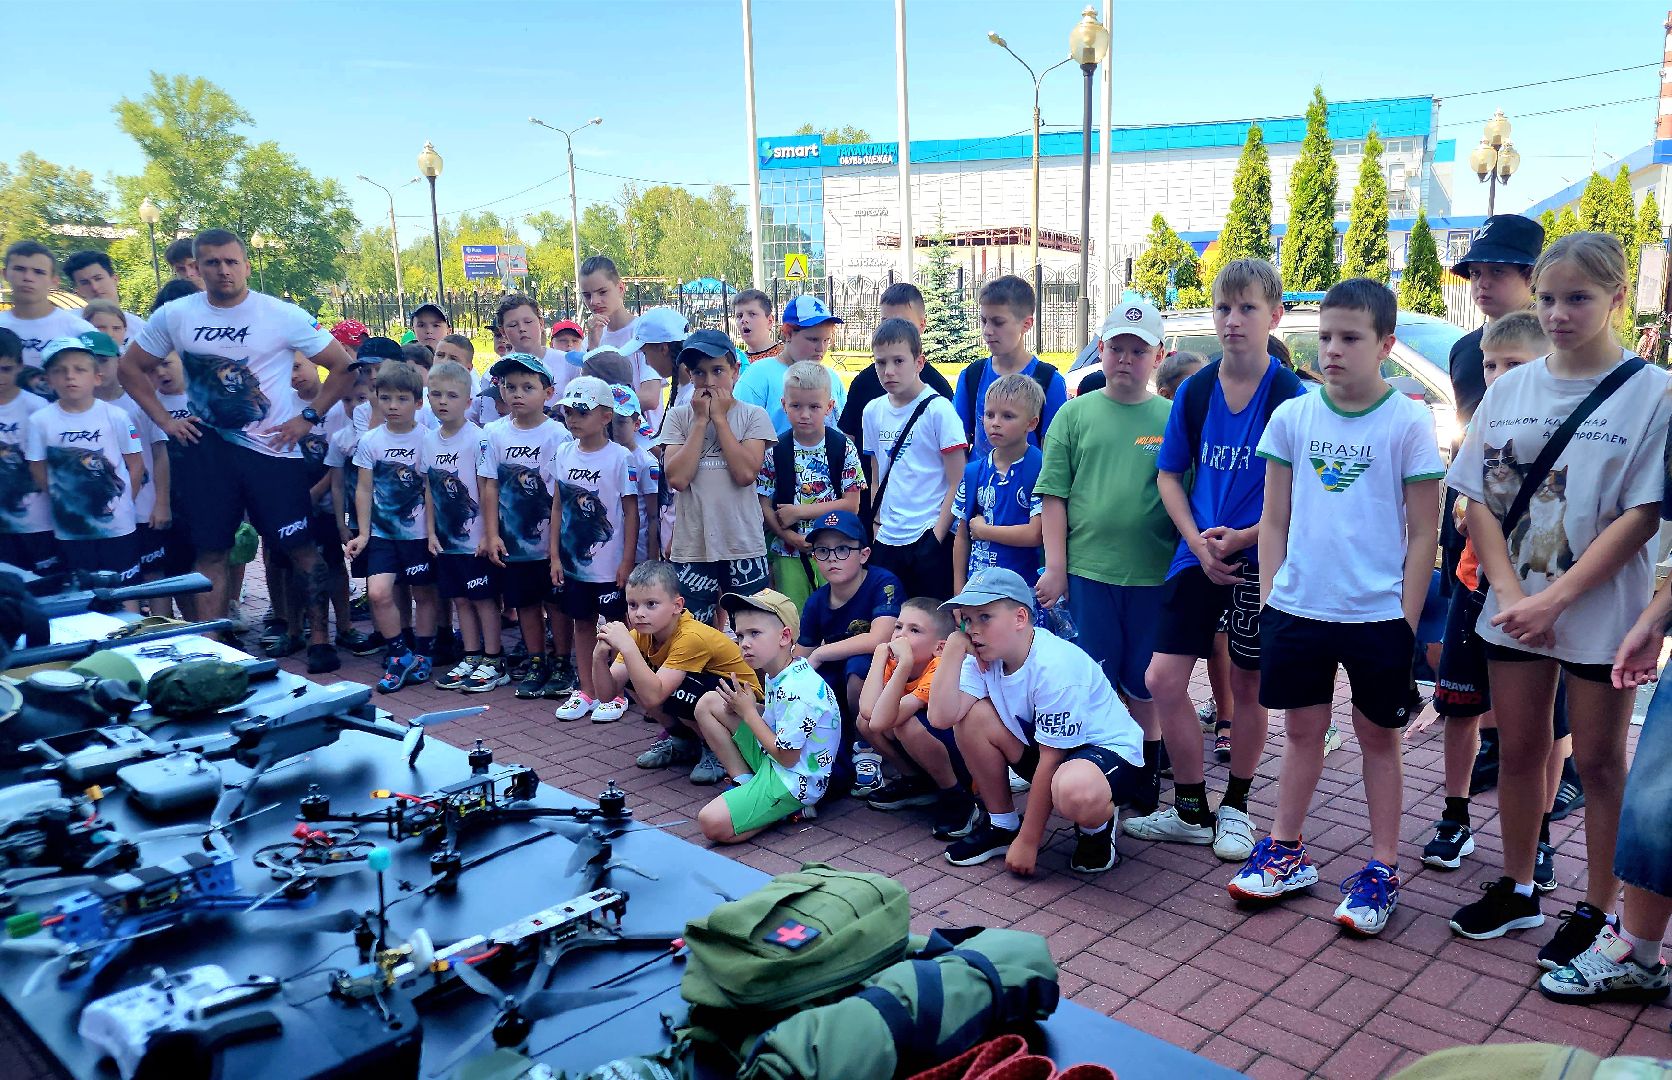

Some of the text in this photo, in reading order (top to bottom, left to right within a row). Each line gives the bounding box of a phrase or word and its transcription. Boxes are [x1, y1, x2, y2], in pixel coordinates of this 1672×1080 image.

[774, 144, 818, 158] smart
[193, 325, 250, 343] TORA
[1489, 417, 1538, 428] СЛИШКОМ
[59, 429, 103, 443] TORA
[384, 447, 416, 460] TORA
[505, 445, 541, 461] TORA
[1309, 440, 1376, 458] BRASIL
[435, 451, 460, 467] TORA
[568, 468, 601, 484] TORA
[278, 516, 308, 540] TORA
[405, 562, 430, 576] TORA
[466, 574, 489, 590] TORA
[1440, 678, 1476, 692] BRAWL
[1036, 711, 1071, 727] KEEP
